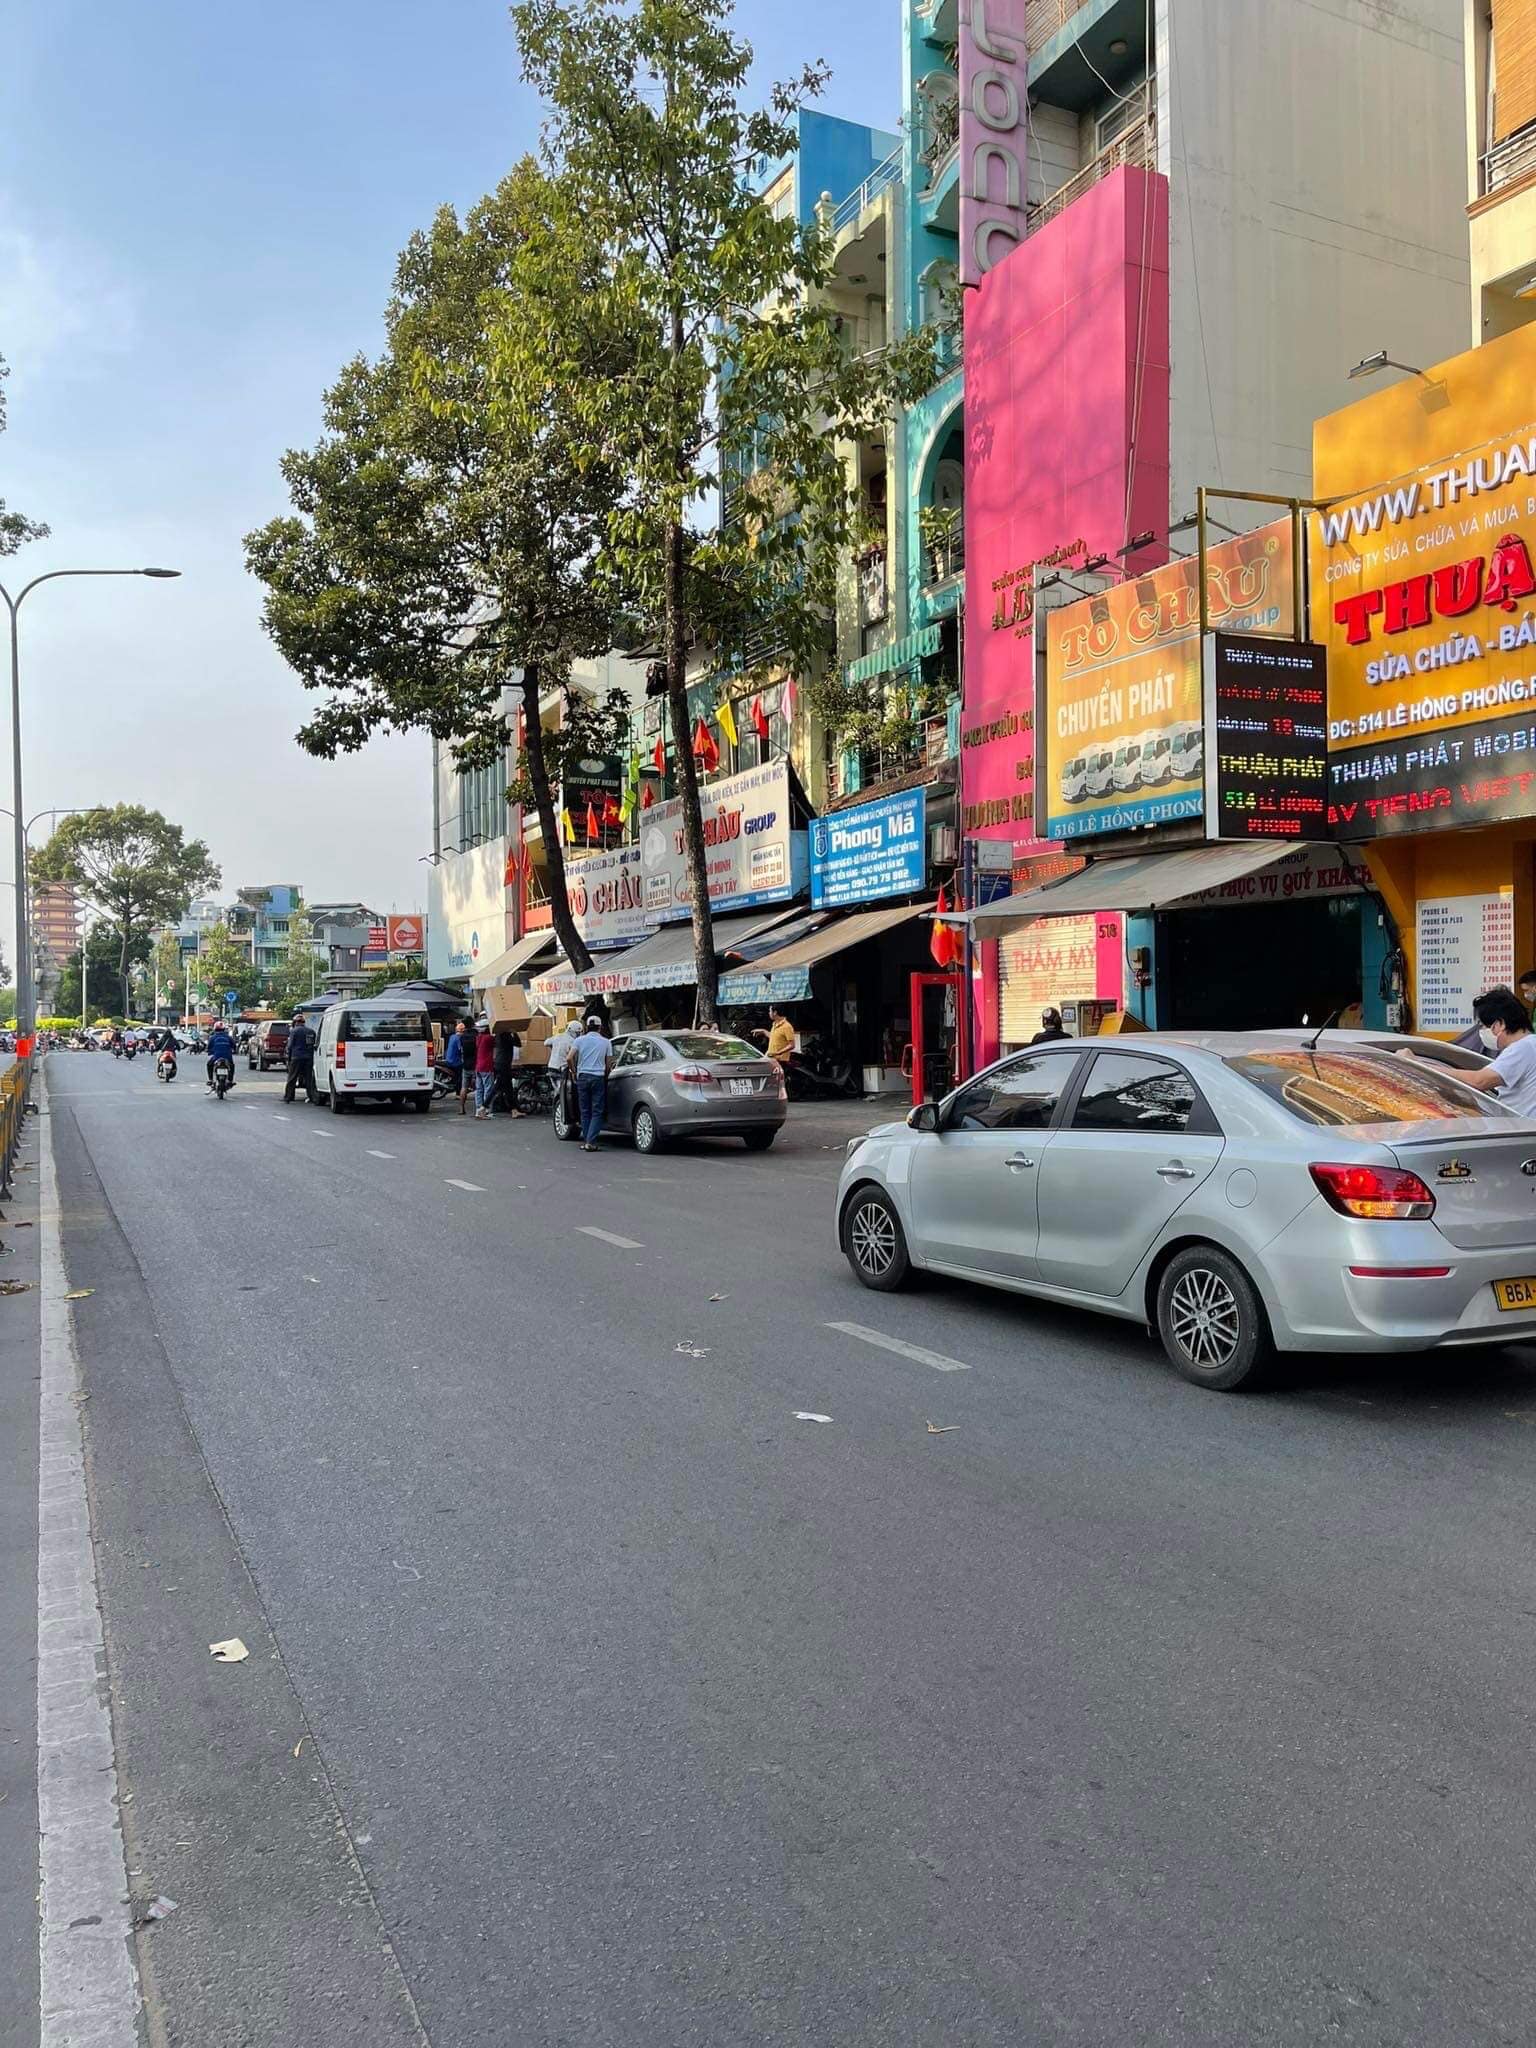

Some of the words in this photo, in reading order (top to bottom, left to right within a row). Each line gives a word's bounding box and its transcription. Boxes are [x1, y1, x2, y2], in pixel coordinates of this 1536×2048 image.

[1484, 503, 1519, 531] MUA
[1499, 611, 1536, 650] BÁ
[1057, 678, 1124, 738] CHUYỂN
[1128, 668, 1176, 716] PHÁT
[1359, 710, 1384, 732] 514
[1387, 702, 1409, 727] LÊ
[1410, 693, 1458, 722] HỒNG
[1219, 752, 1279, 779] THUẬN
[1282, 754, 1326, 778] PHÁT
[1331, 753, 1397, 785] THUẬN
[1406, 739, 1464, 772] PHÁT
[1225, 791, 1257, 810] 514
[744, 811, 777, 836] GROUP
[831, 824, 882, 853] Phong
[888, 811, 915, 839] Mã
[1054, 822, 1075, 838] 516
[1078, 814, 1097, 832] LÊ
[1101, 804, 1145, 829] HỒNG
[592, 866, 642, 914] CHÂU
[1260, 873, 1280, 897] VỤ
[583, 975, 621, 994] TP.HCM
